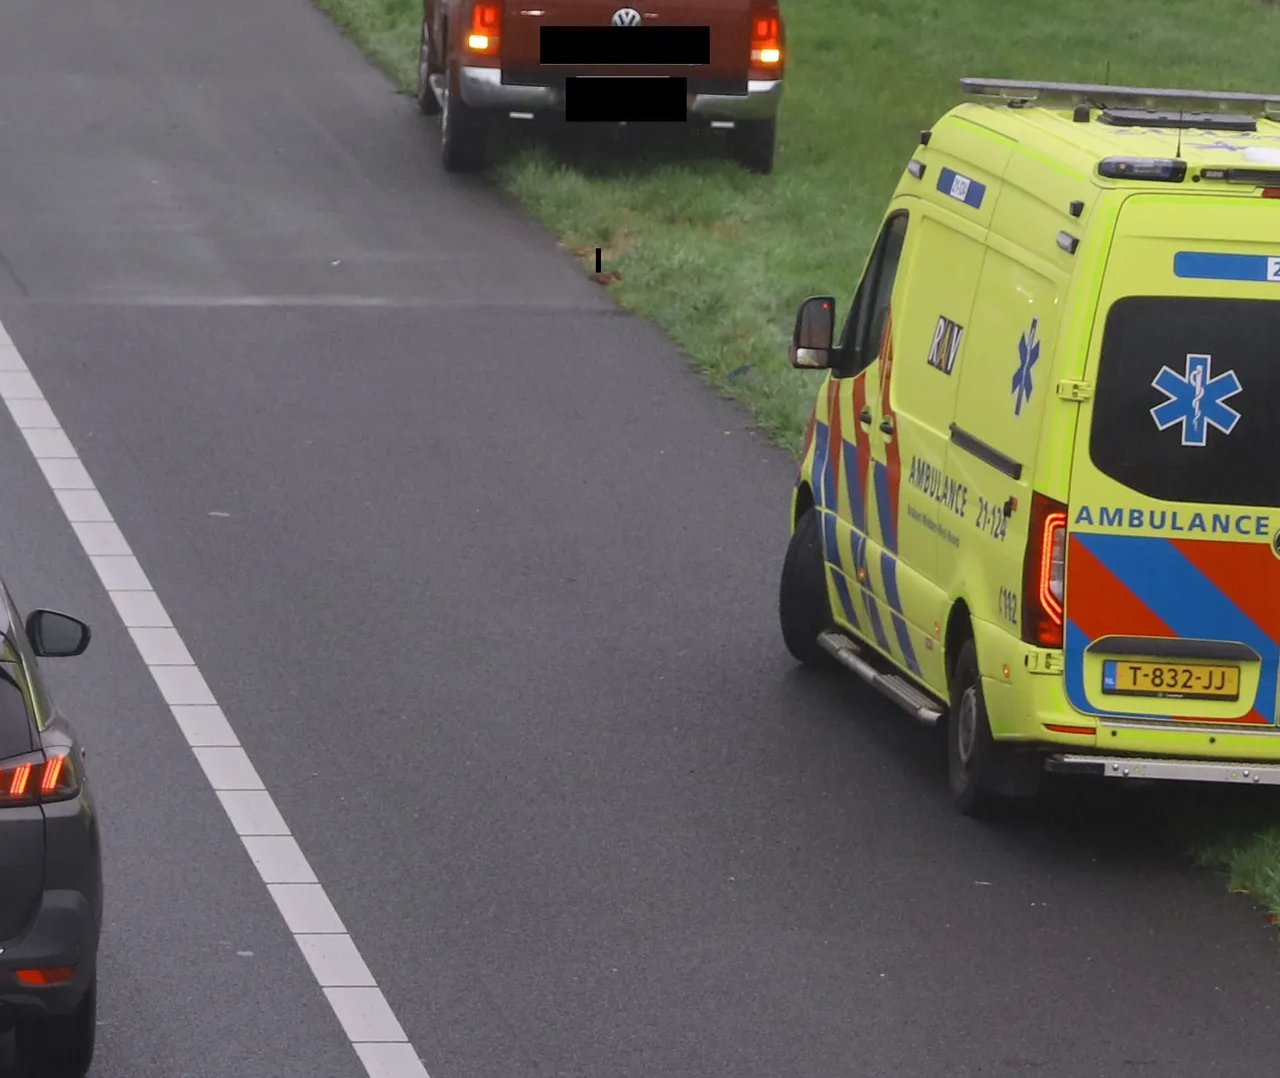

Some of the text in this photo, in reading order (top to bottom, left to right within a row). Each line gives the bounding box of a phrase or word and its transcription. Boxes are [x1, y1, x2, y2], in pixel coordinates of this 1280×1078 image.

[928, 317, 963, 371] RAV
[908, 455, 968, 517] AMBULANCE
[1075, 505, 1270, 535] AMBULANCE
[1129, 666, 1226, 690] T-832-JJ
